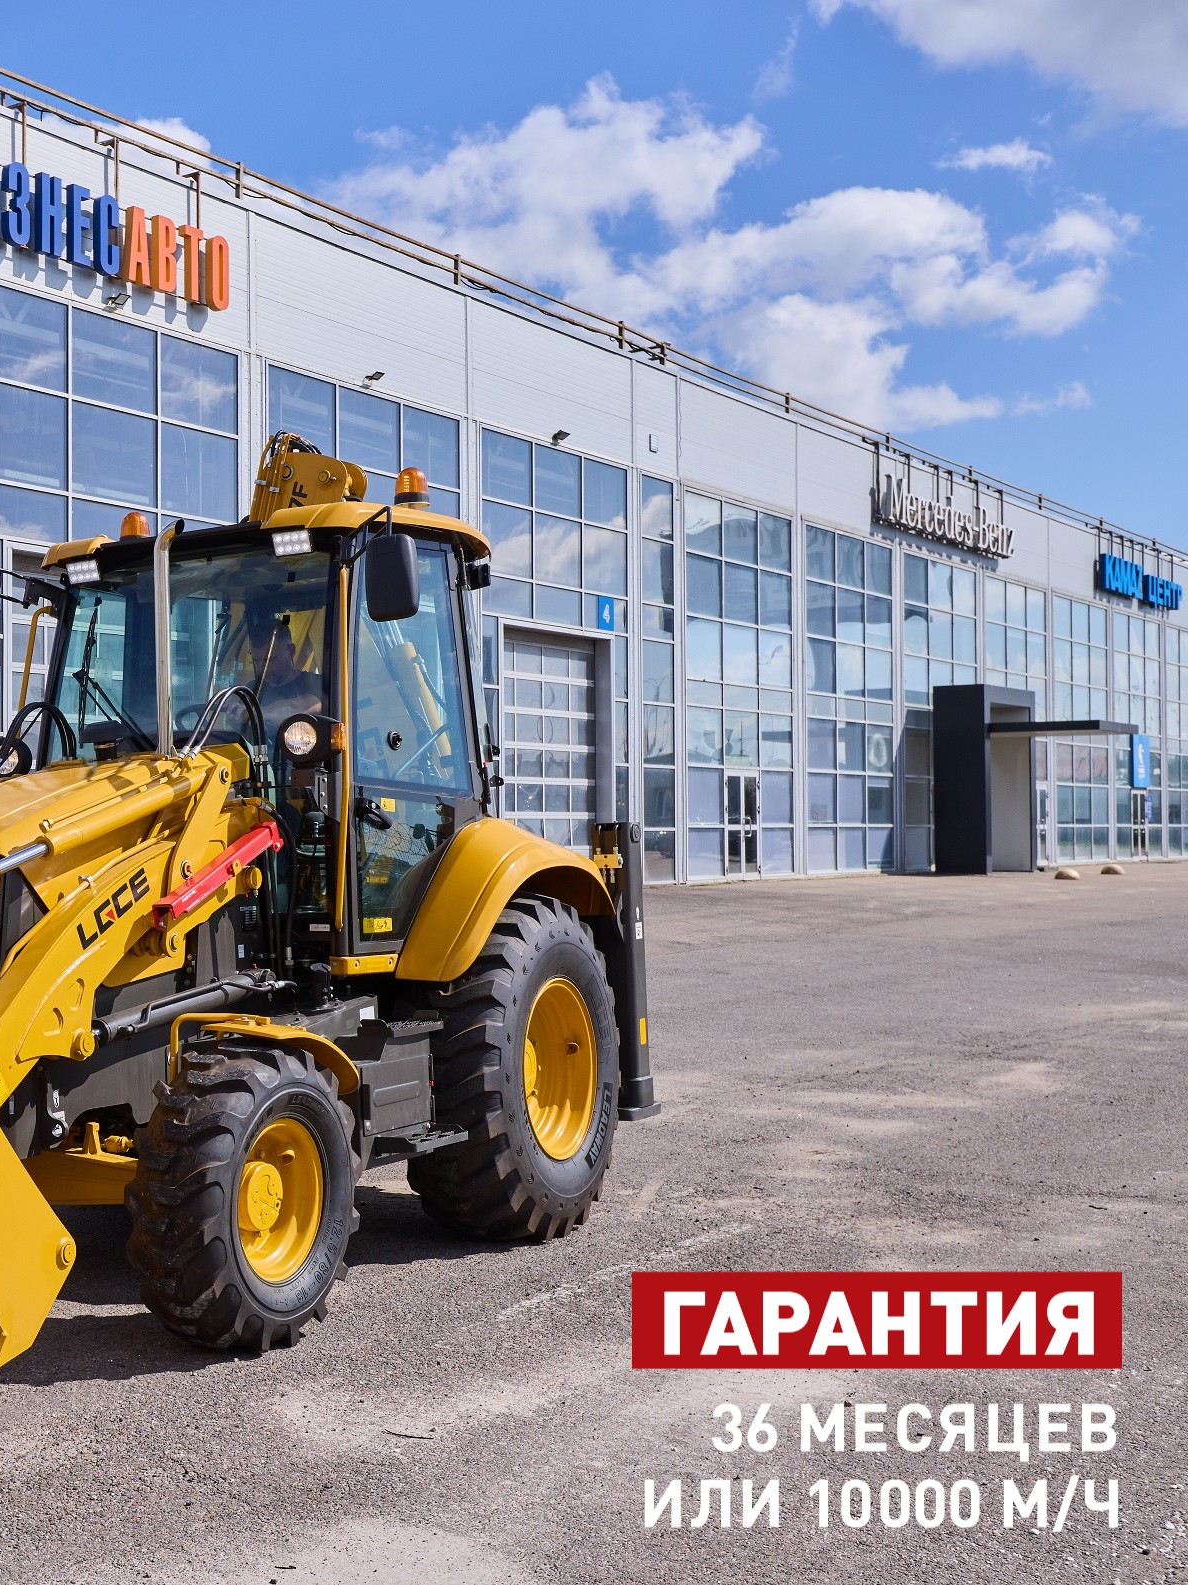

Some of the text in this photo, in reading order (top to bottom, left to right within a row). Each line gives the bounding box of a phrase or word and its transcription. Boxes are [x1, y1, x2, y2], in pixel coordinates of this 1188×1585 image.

[885, 474, 1016, 558] Mercedes-Benz
[602, 604, 611, 623] 4
[1145, 574, 1183, 610] ЦЕНТР
[588, 1089, 611, 1166] LEADWAY
